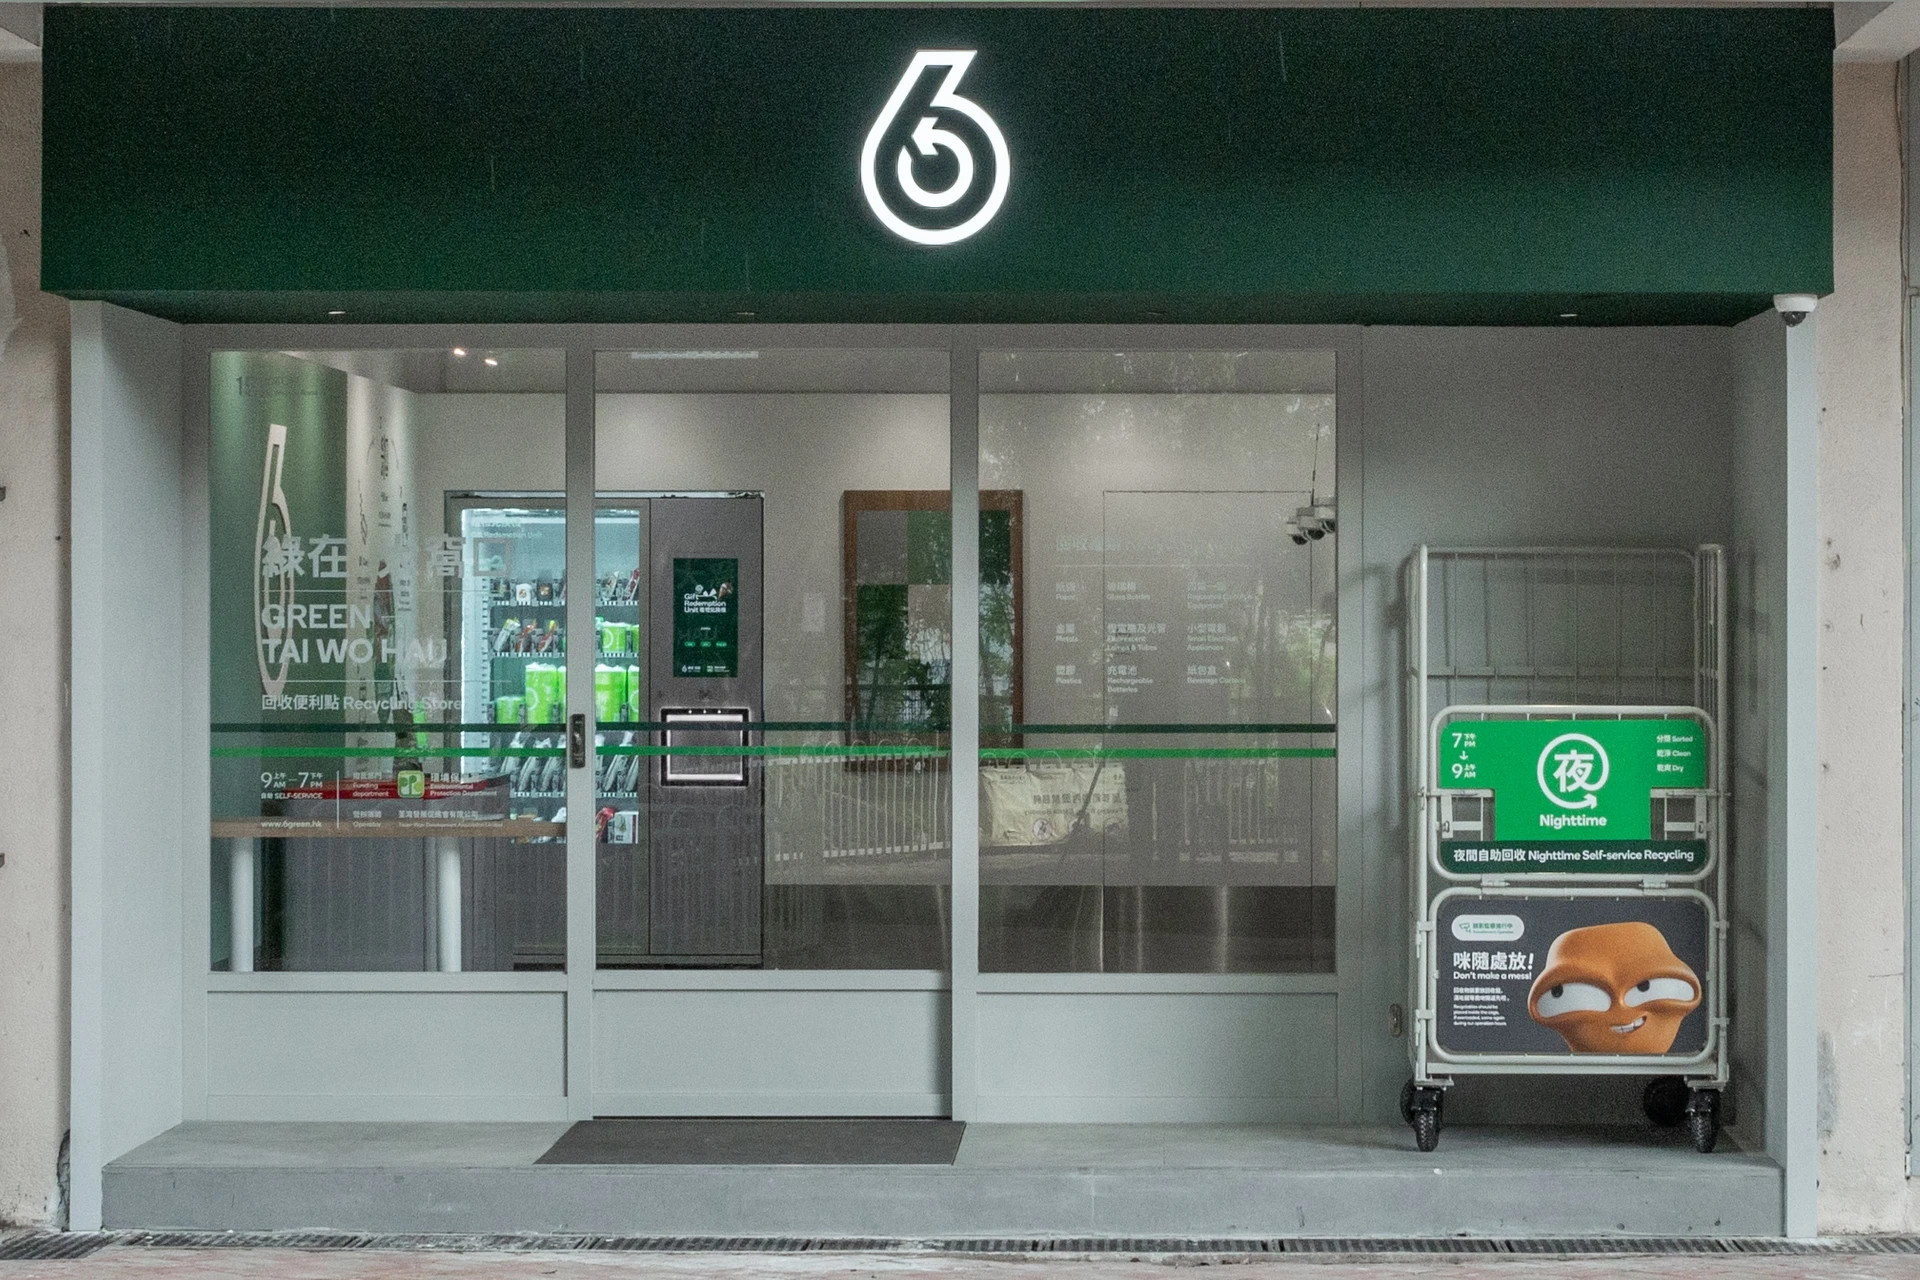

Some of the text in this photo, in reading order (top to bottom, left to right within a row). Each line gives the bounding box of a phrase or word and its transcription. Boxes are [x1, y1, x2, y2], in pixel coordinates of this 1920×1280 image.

[262, 534, 513, 579] 綠在窩口
[261, 603, 371, 629] GREEN
[262, 638, 448, 664] TAI WO HAU
[262, 694, 339, 711] 回收便利點
[343, 696, 461, 713] Recycling Store
[1452, 733, 1462, 748] 7
[1452, 763, 1463, 779] 9
[1553, 750, 1595, 793] 夜
[1672, 765, 1684, 773] Dry
[298, 772, 310, 788] 7
[1539, 814, 1607, 830] Nighttime
[1453, 849, 1695, 863] 夜間自助回收 Nighttime Self-service Recycling
[1453, 951, 1535, 971] 咪隨處放!
[1453, 971, 1476, 980] Don't
[1477, 971, 1500, 980] make
[1508, 971, 1532, 980] mess!
